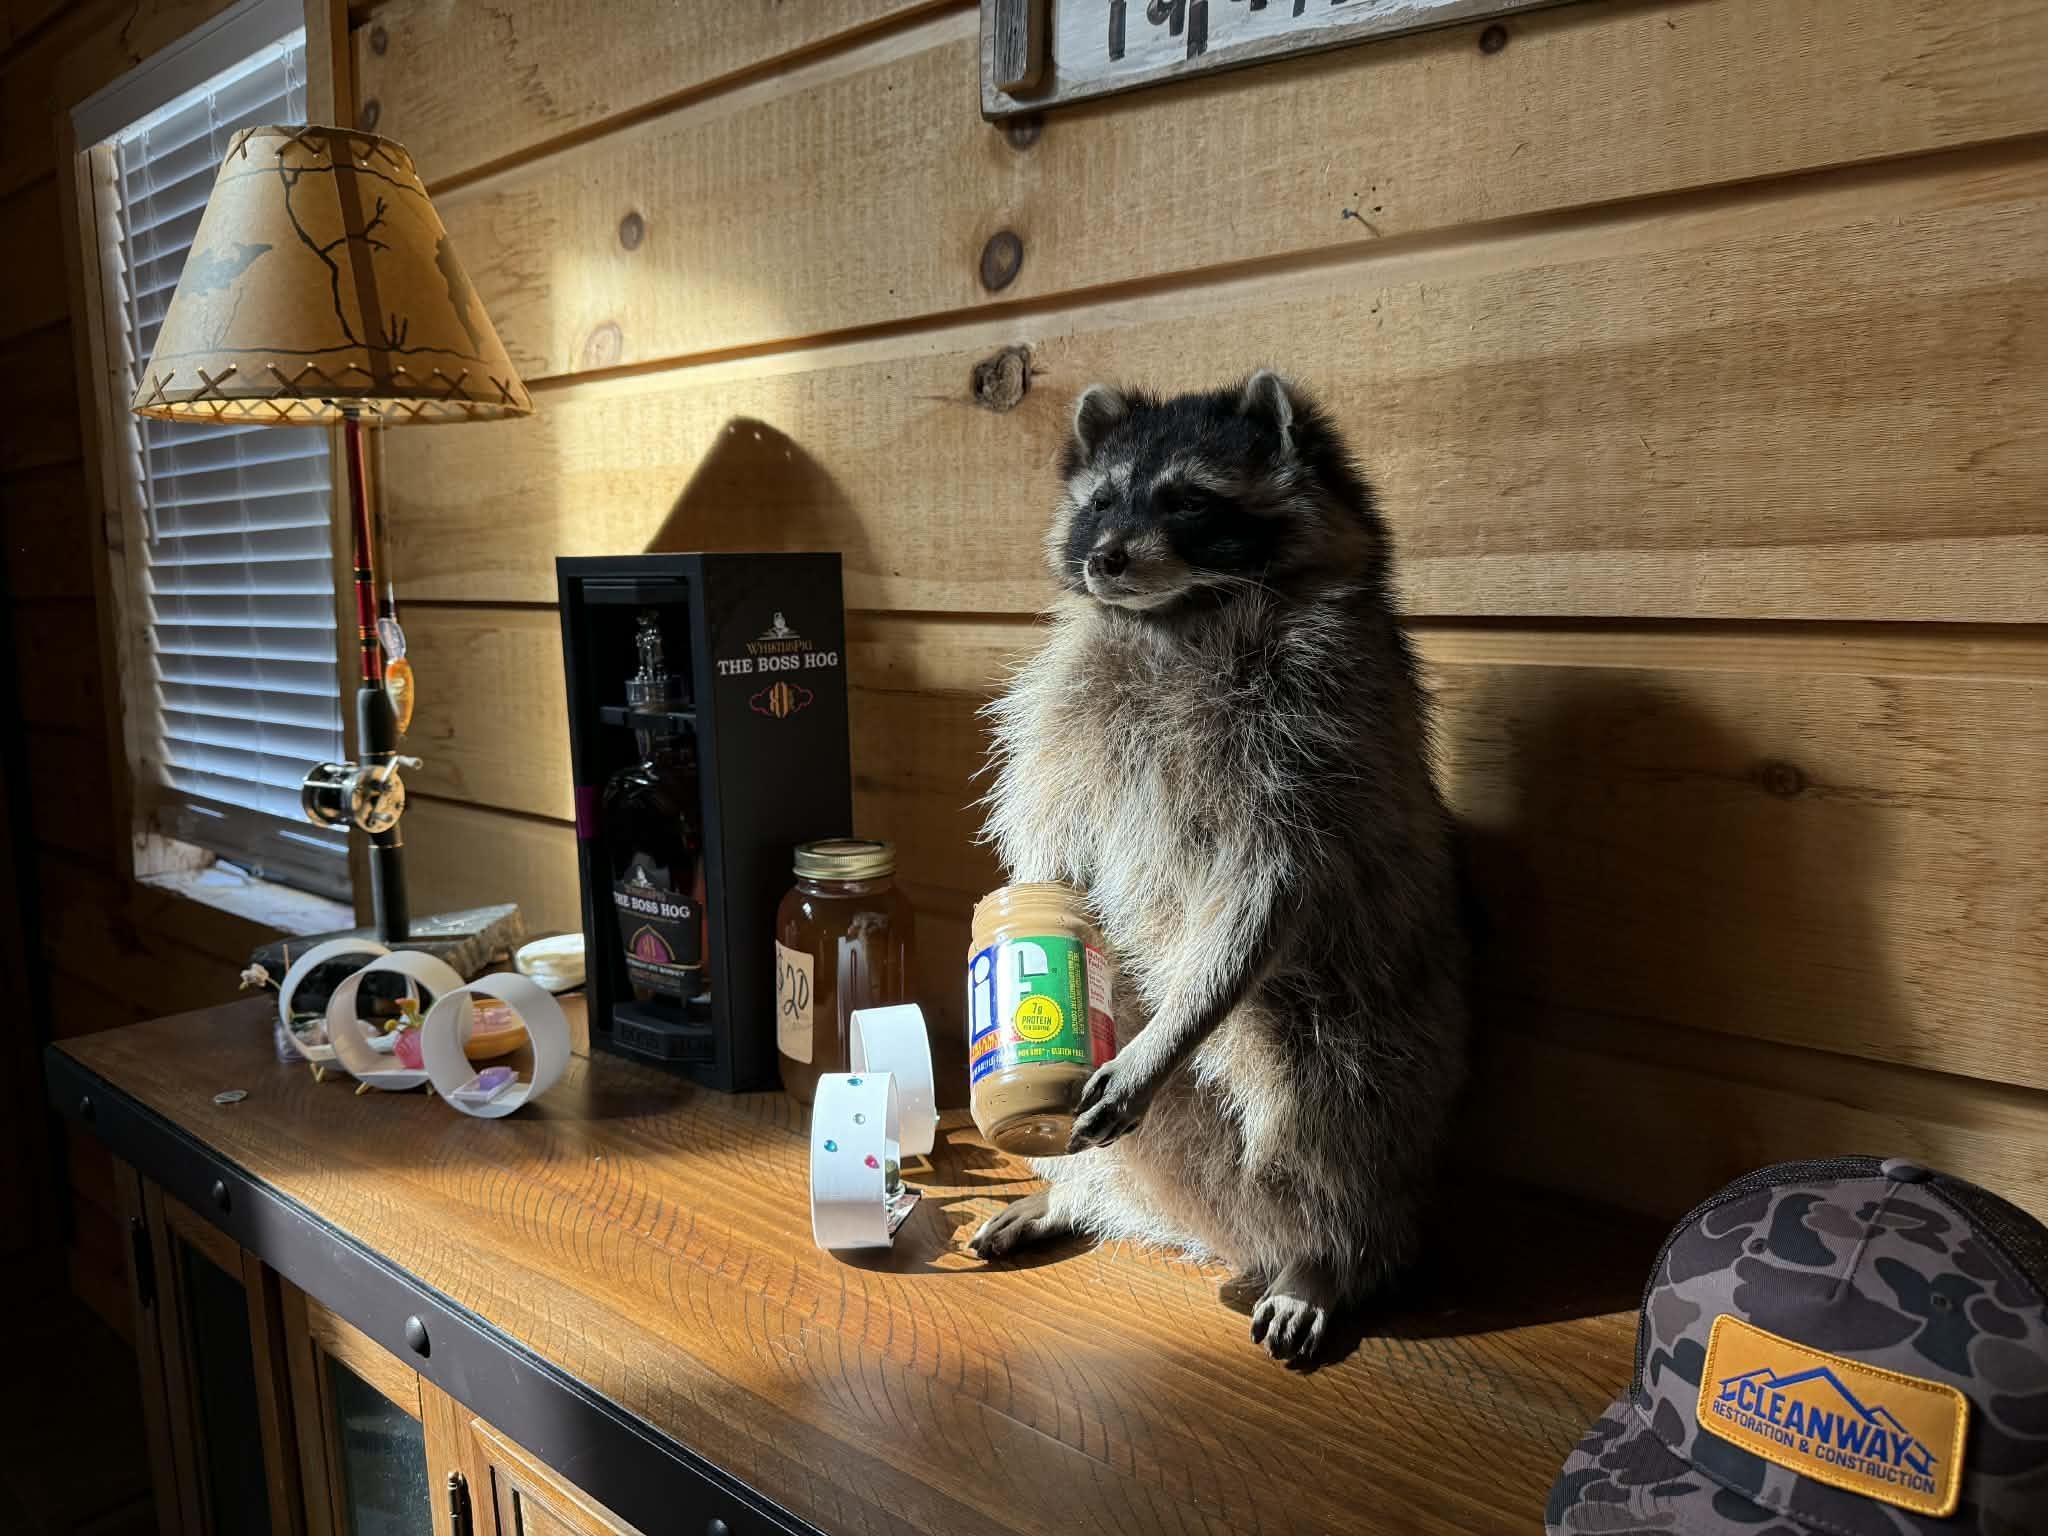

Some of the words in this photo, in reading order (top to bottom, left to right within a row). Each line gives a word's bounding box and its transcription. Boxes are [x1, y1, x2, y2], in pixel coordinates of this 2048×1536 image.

[717, 658, 753, 675] THE
[758, 654, 800, 672] BOSS
[803, 651, 838, 668] HOG
[632, 896, 659, 914] BOSS
[661, 903, 691, 918] HOG
[1021, 1015, 1052, 1025] PROTEIN
[1032, 1003, 1043, 1015] 7g
[1737, 1379, 1914, 1466] CLEANWAY
[1712, 1400, 1794, 1449] RESTORATION
[1798, 1438, 1809, 1454] &
[1815, 1444, 1936, 1494] CONSTRUCTION
